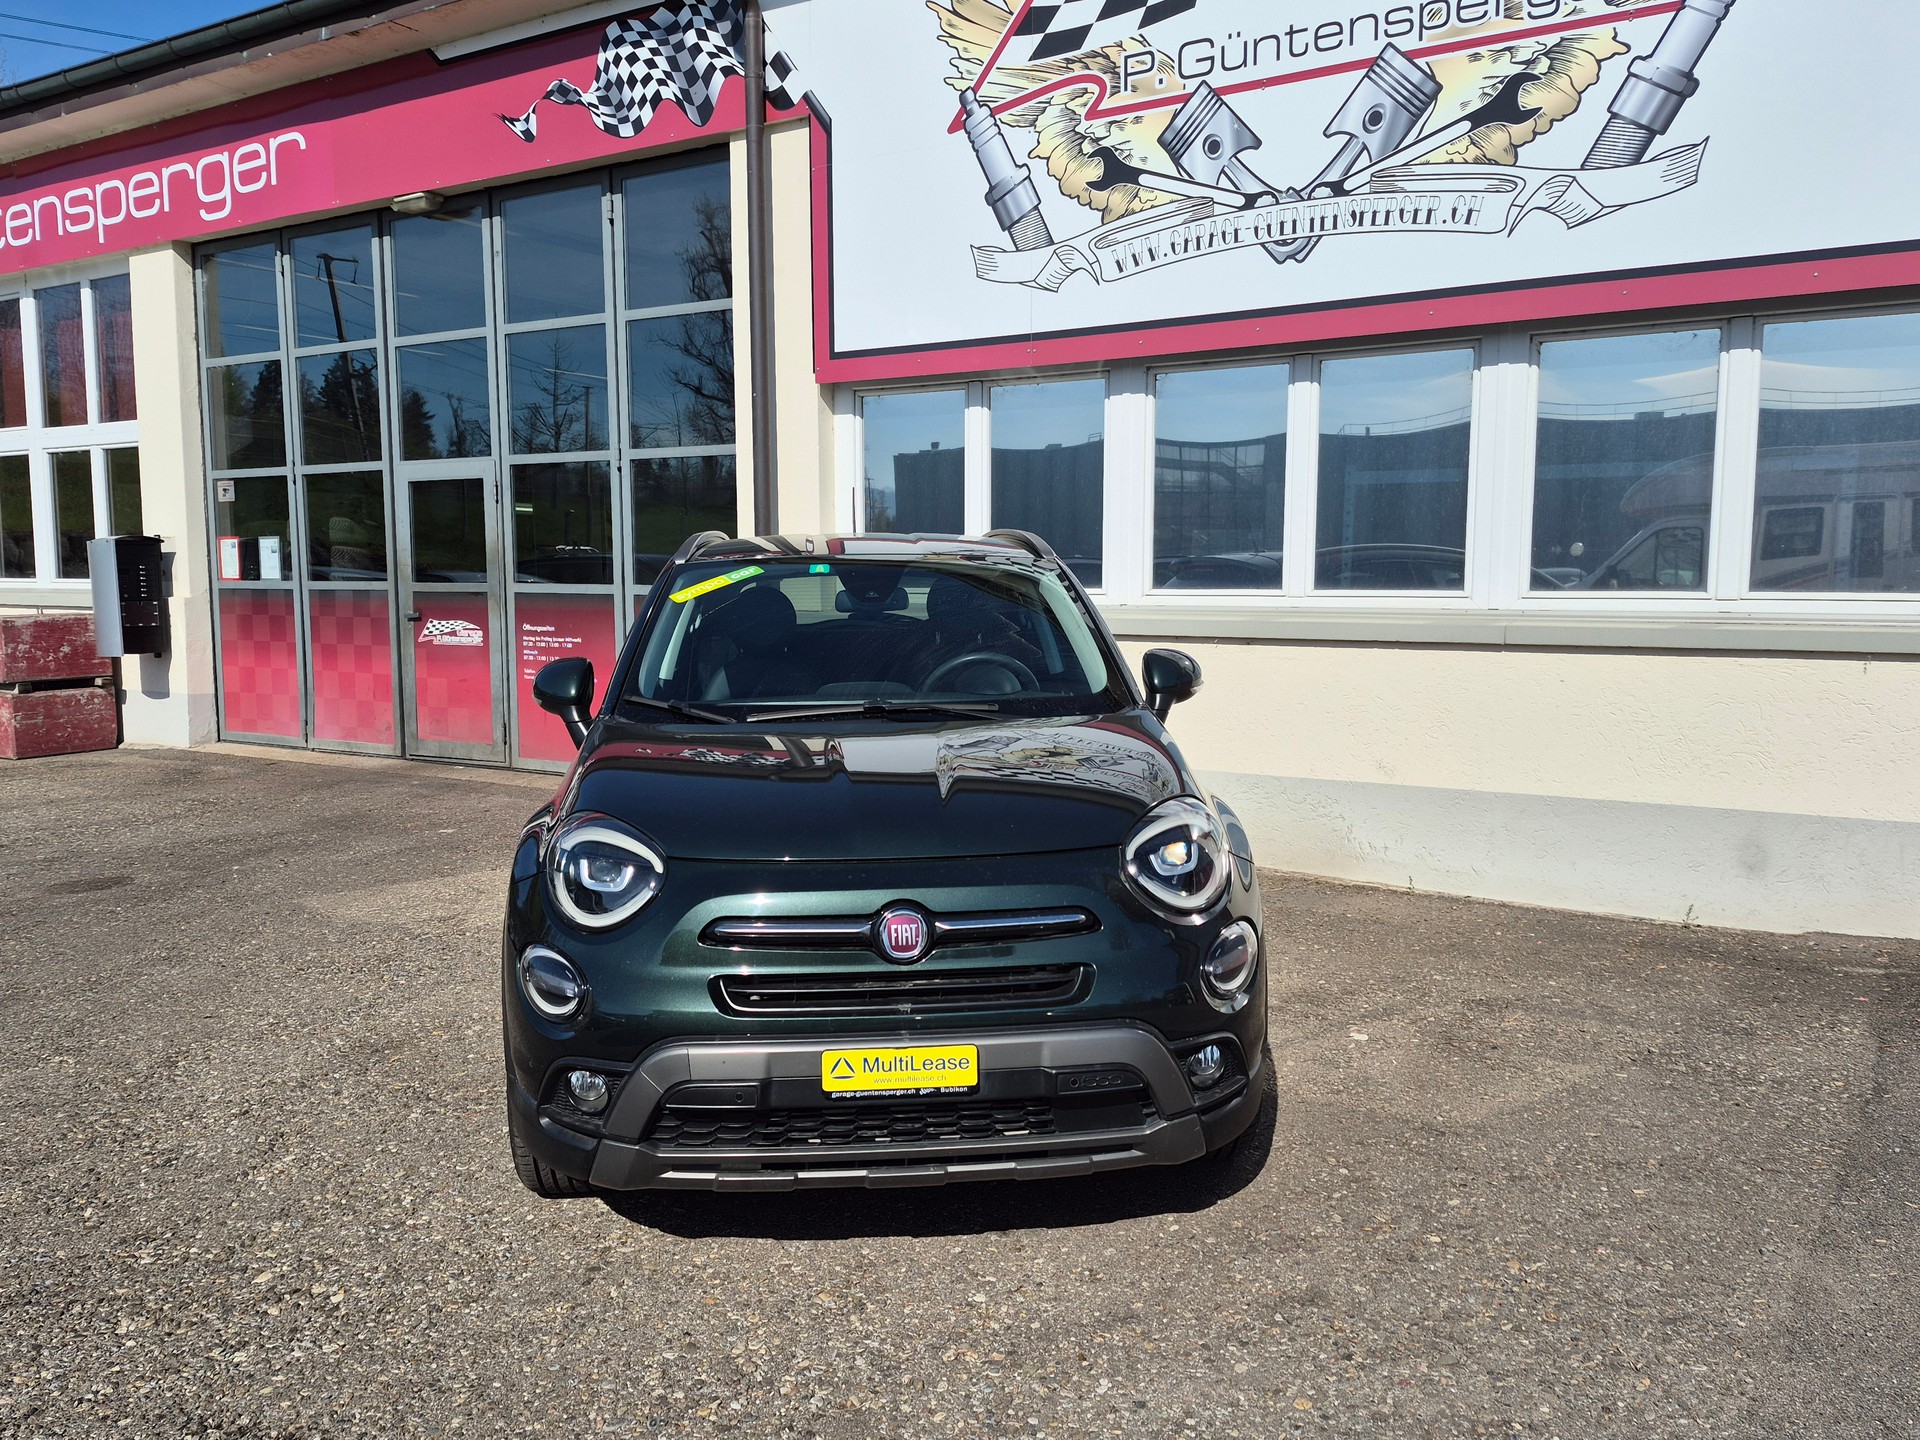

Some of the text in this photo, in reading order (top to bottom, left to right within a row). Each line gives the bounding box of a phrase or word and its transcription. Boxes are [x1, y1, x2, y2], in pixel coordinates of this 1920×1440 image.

[1110, 193, 1487, 275] WWW.GARAGE-GUENTENSPERGER.CH
[731, 567, 756, 579] car
[890, 924, 918, 946] FIAT
[862, 1055, 970, 1074] MultiLease
[873, 1075, 947, 1085] www.multilease.ch
[831, 1088, 916, 1099] garage-guentensperger.ch
